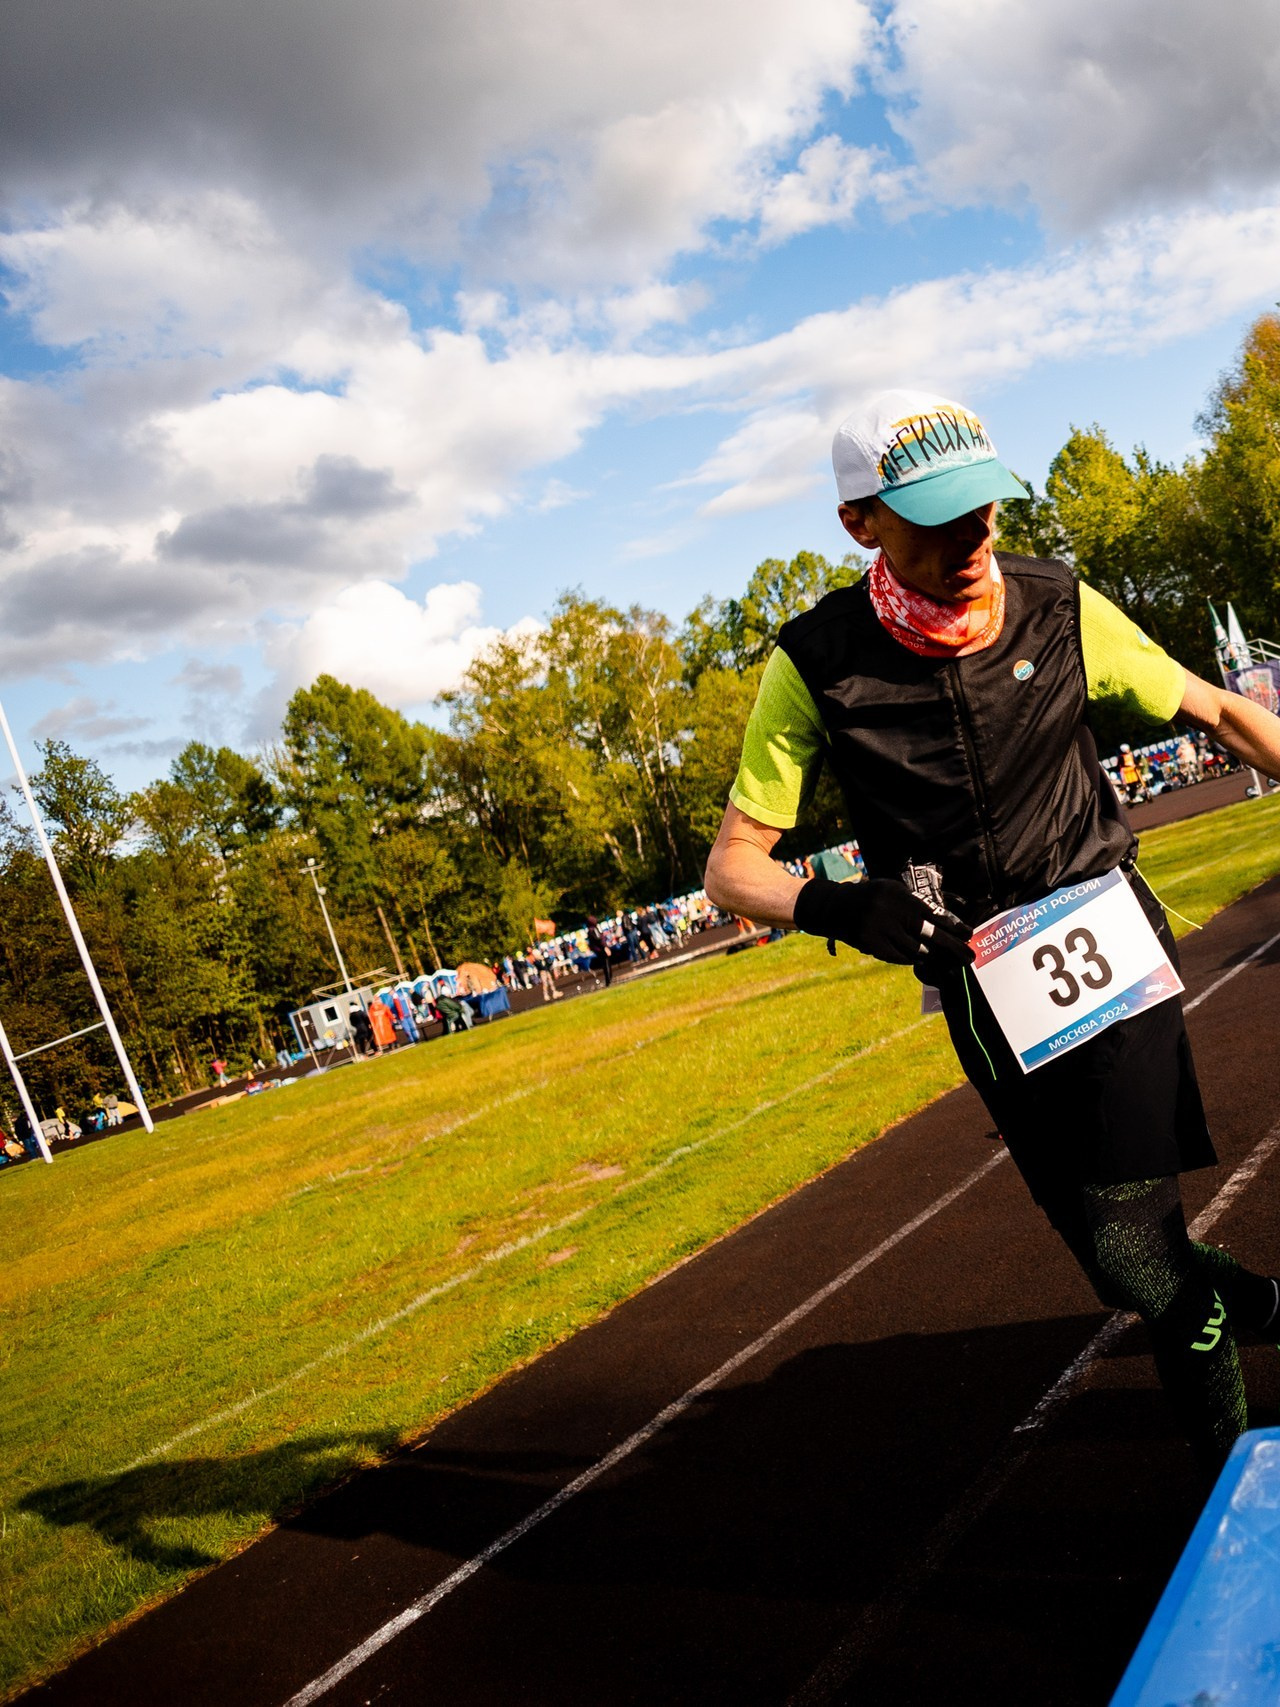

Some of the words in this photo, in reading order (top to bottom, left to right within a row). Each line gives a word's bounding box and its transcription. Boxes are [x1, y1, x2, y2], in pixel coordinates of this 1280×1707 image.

[976, 904, 1048, 948] ЧЕМПИОНАТ
[1050, 879, 1102, 909] РОССИИ
[980, 948, 991, 958] ПО
[992, 938, 1009, 951] БЕГУ
[1009, 932, 1019, 942] 24
[1019, 921, 1039, 935] ЧАСА
[1032, 927, 1113, 1007] 33
[1048, 1019, 1098, 1051] МОСКВА
[1098, 1002, 1129, 1023] 2024
